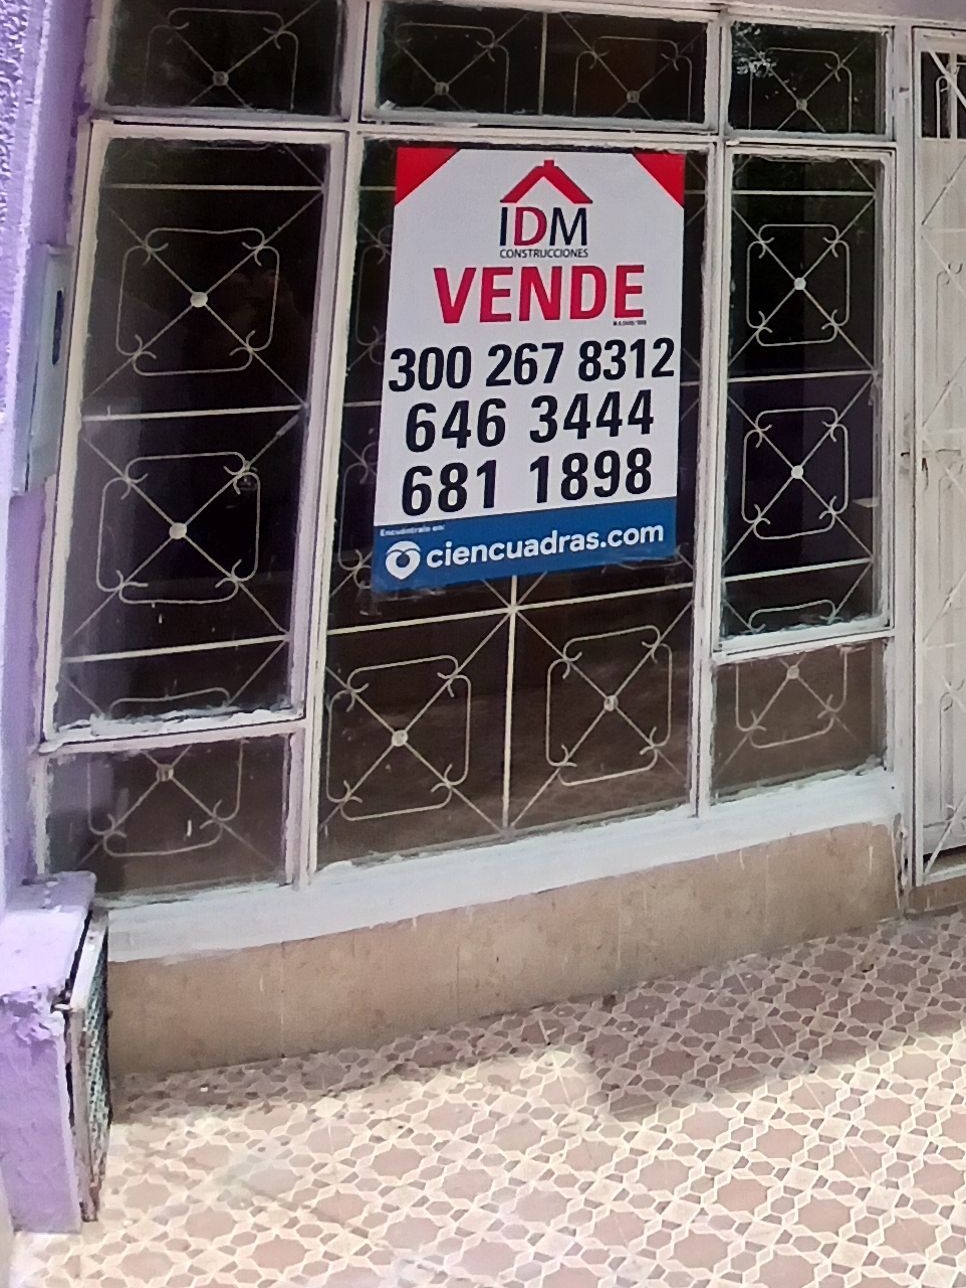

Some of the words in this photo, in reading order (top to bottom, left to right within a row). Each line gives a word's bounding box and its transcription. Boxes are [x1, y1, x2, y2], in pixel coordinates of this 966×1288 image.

[499, 206, 588, 246] IDM
[499, 248, 589, 259] CONSTRUCCIONES
[433, 264, 645, 324] VENDE
[388, 345, 472, 393] 300
[485, 341, 565, 387] 267
[578, 337, 675, 382] 8312
[405, 398, 507, 452] 646
[529, 389, 654, 444] 3444
[401, 459, 497, 516] 681
[530, 447, 653, 504] 1898
[426, 522, 665, 569] ciencuadras.com
